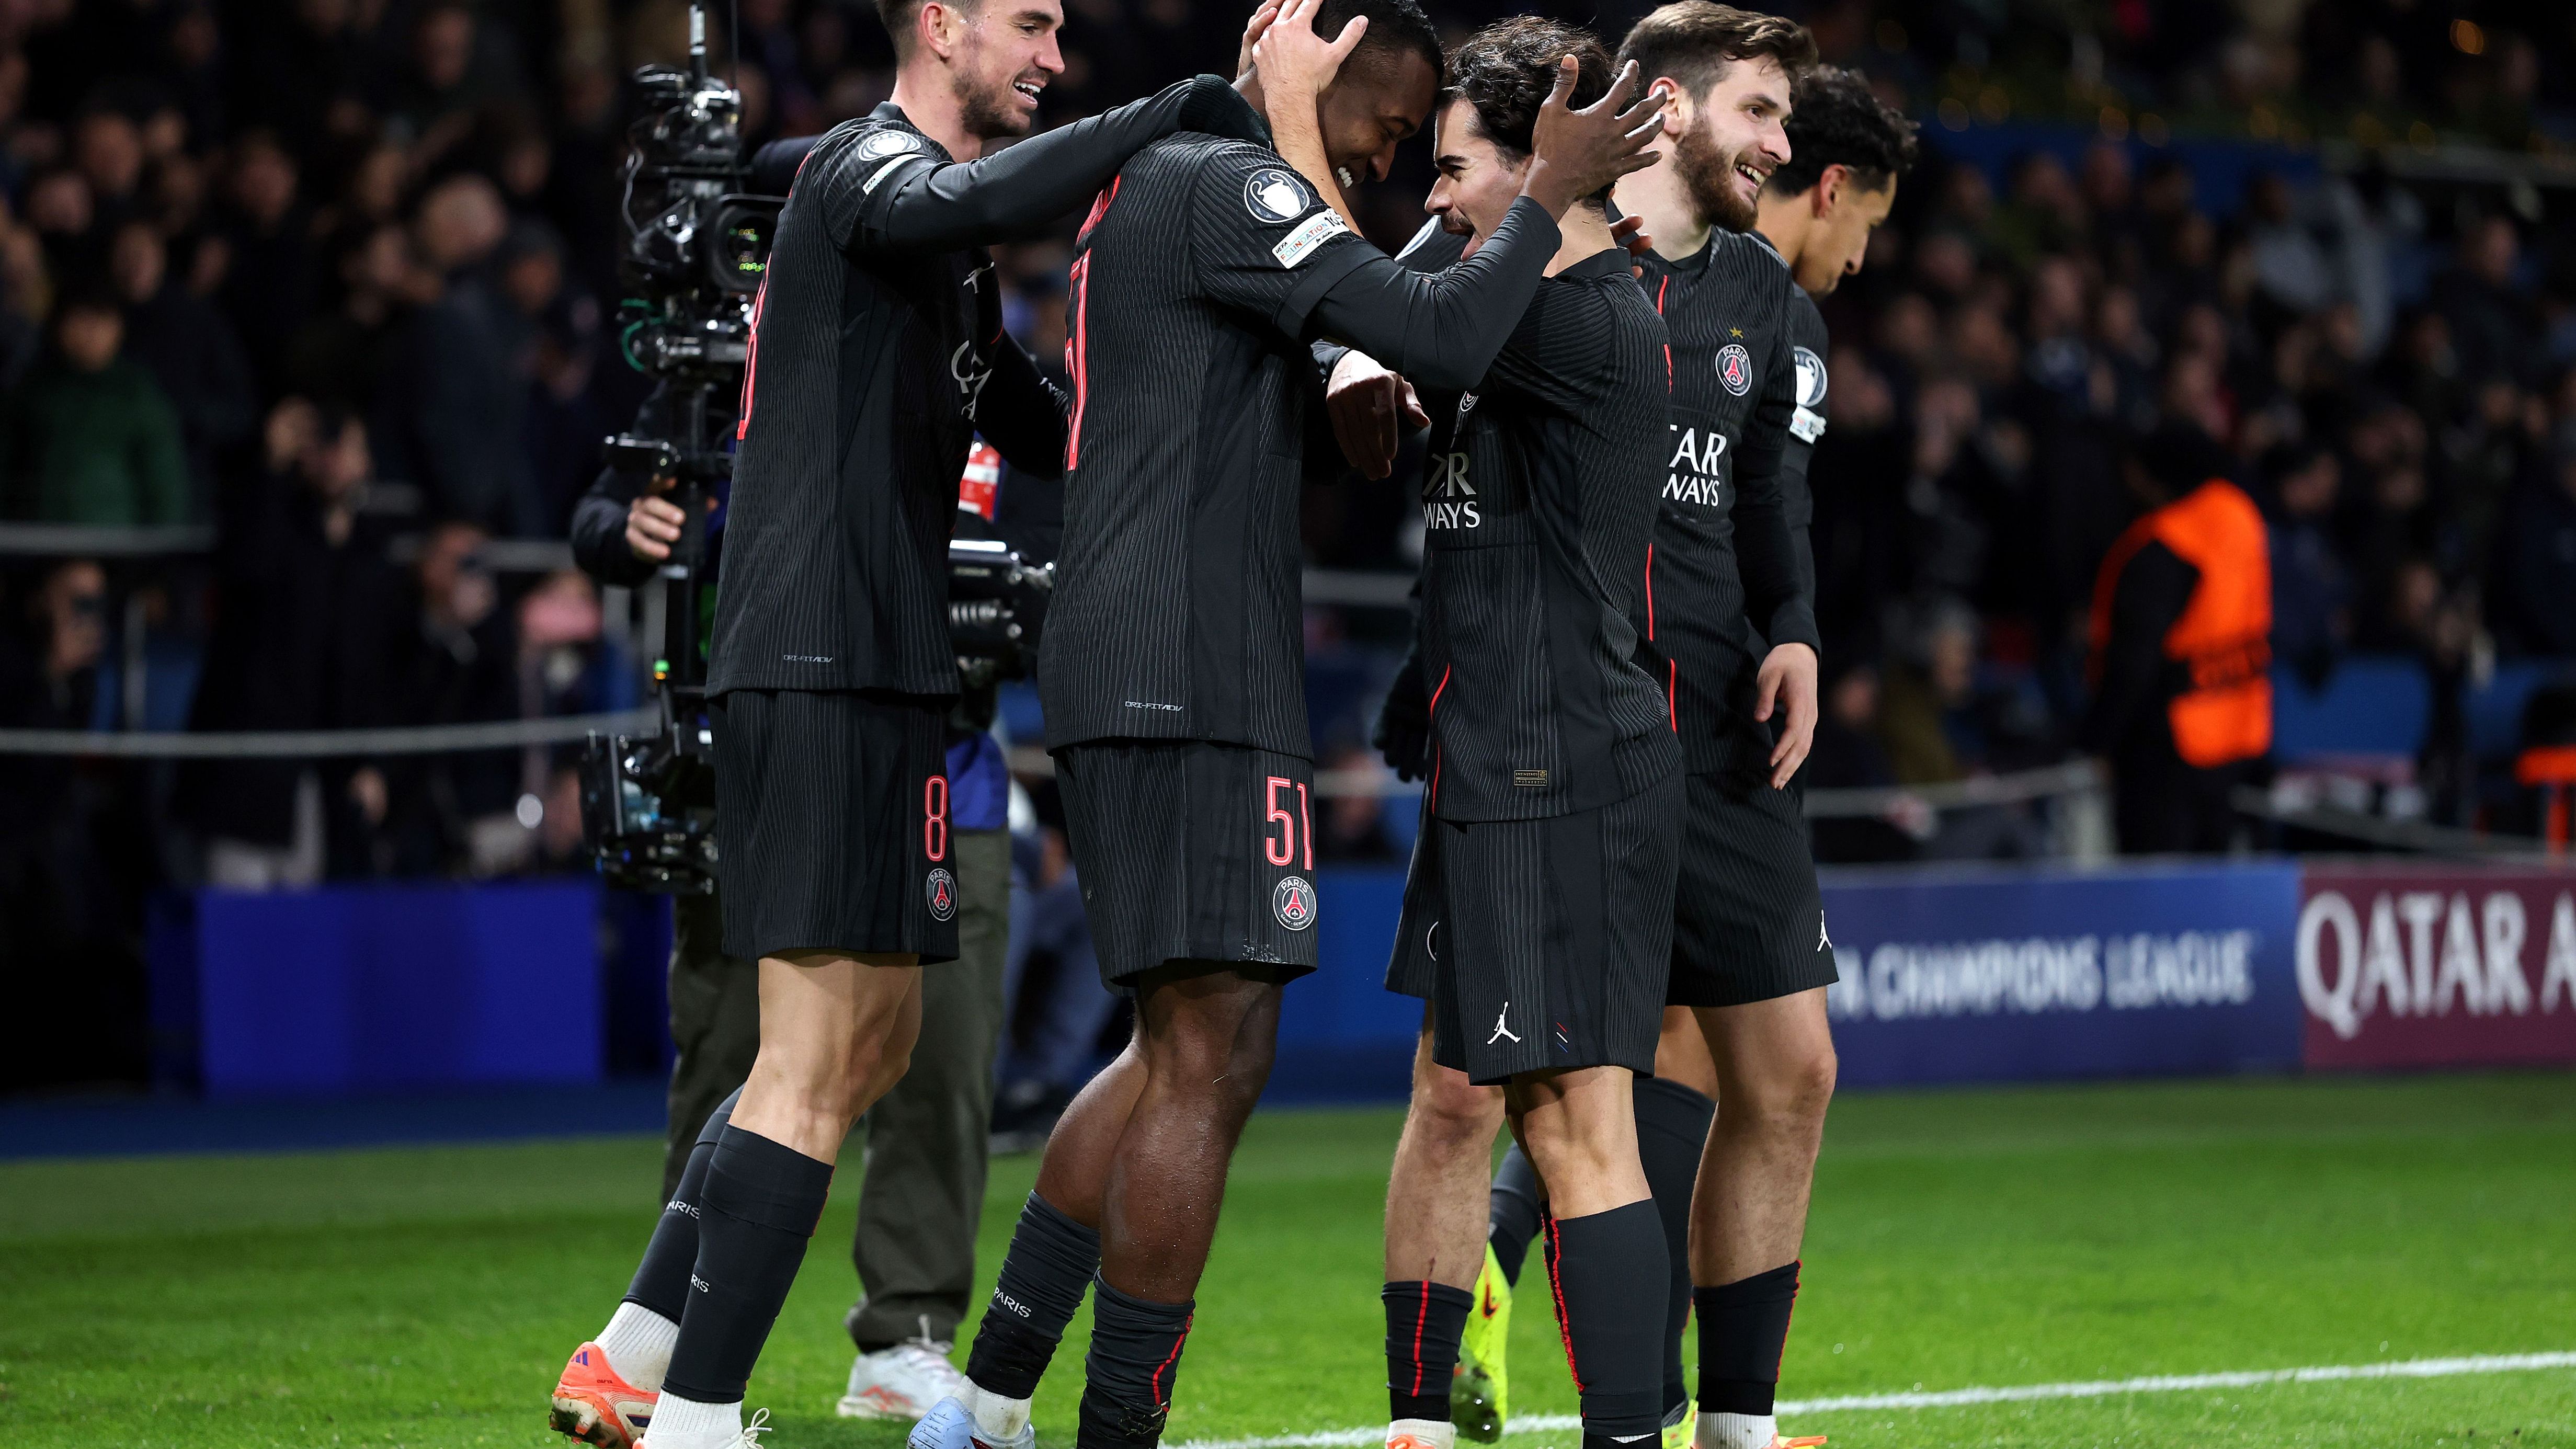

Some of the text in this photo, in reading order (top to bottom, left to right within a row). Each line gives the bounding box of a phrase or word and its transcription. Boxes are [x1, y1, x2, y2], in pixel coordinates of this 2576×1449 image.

[1275, 242, 1288, 254] UEFA
[1723, 347, 1747, 363] PARIS
[1669, 424, 1727, 476] AR
[1422, 500, 1480, 529] WAYS
[925, 775, 948, 862] 8
[1266, 776, 1312, 871] 51
[930, 871, 951, 884] PARIS
[1280, 879, 1309, 893] PARIS
[1869, 938, 2102, 1020] CHAMPIONS
[2105, 932, 2253, 1008] LEAGUE
[2295, 891, 2530, 1040] QATAR
[666, 1200, 700, 1219] ARIS
[691, 1273, 709, 1293] RIS
[994, 1286, 1032, 1318] PARIS
